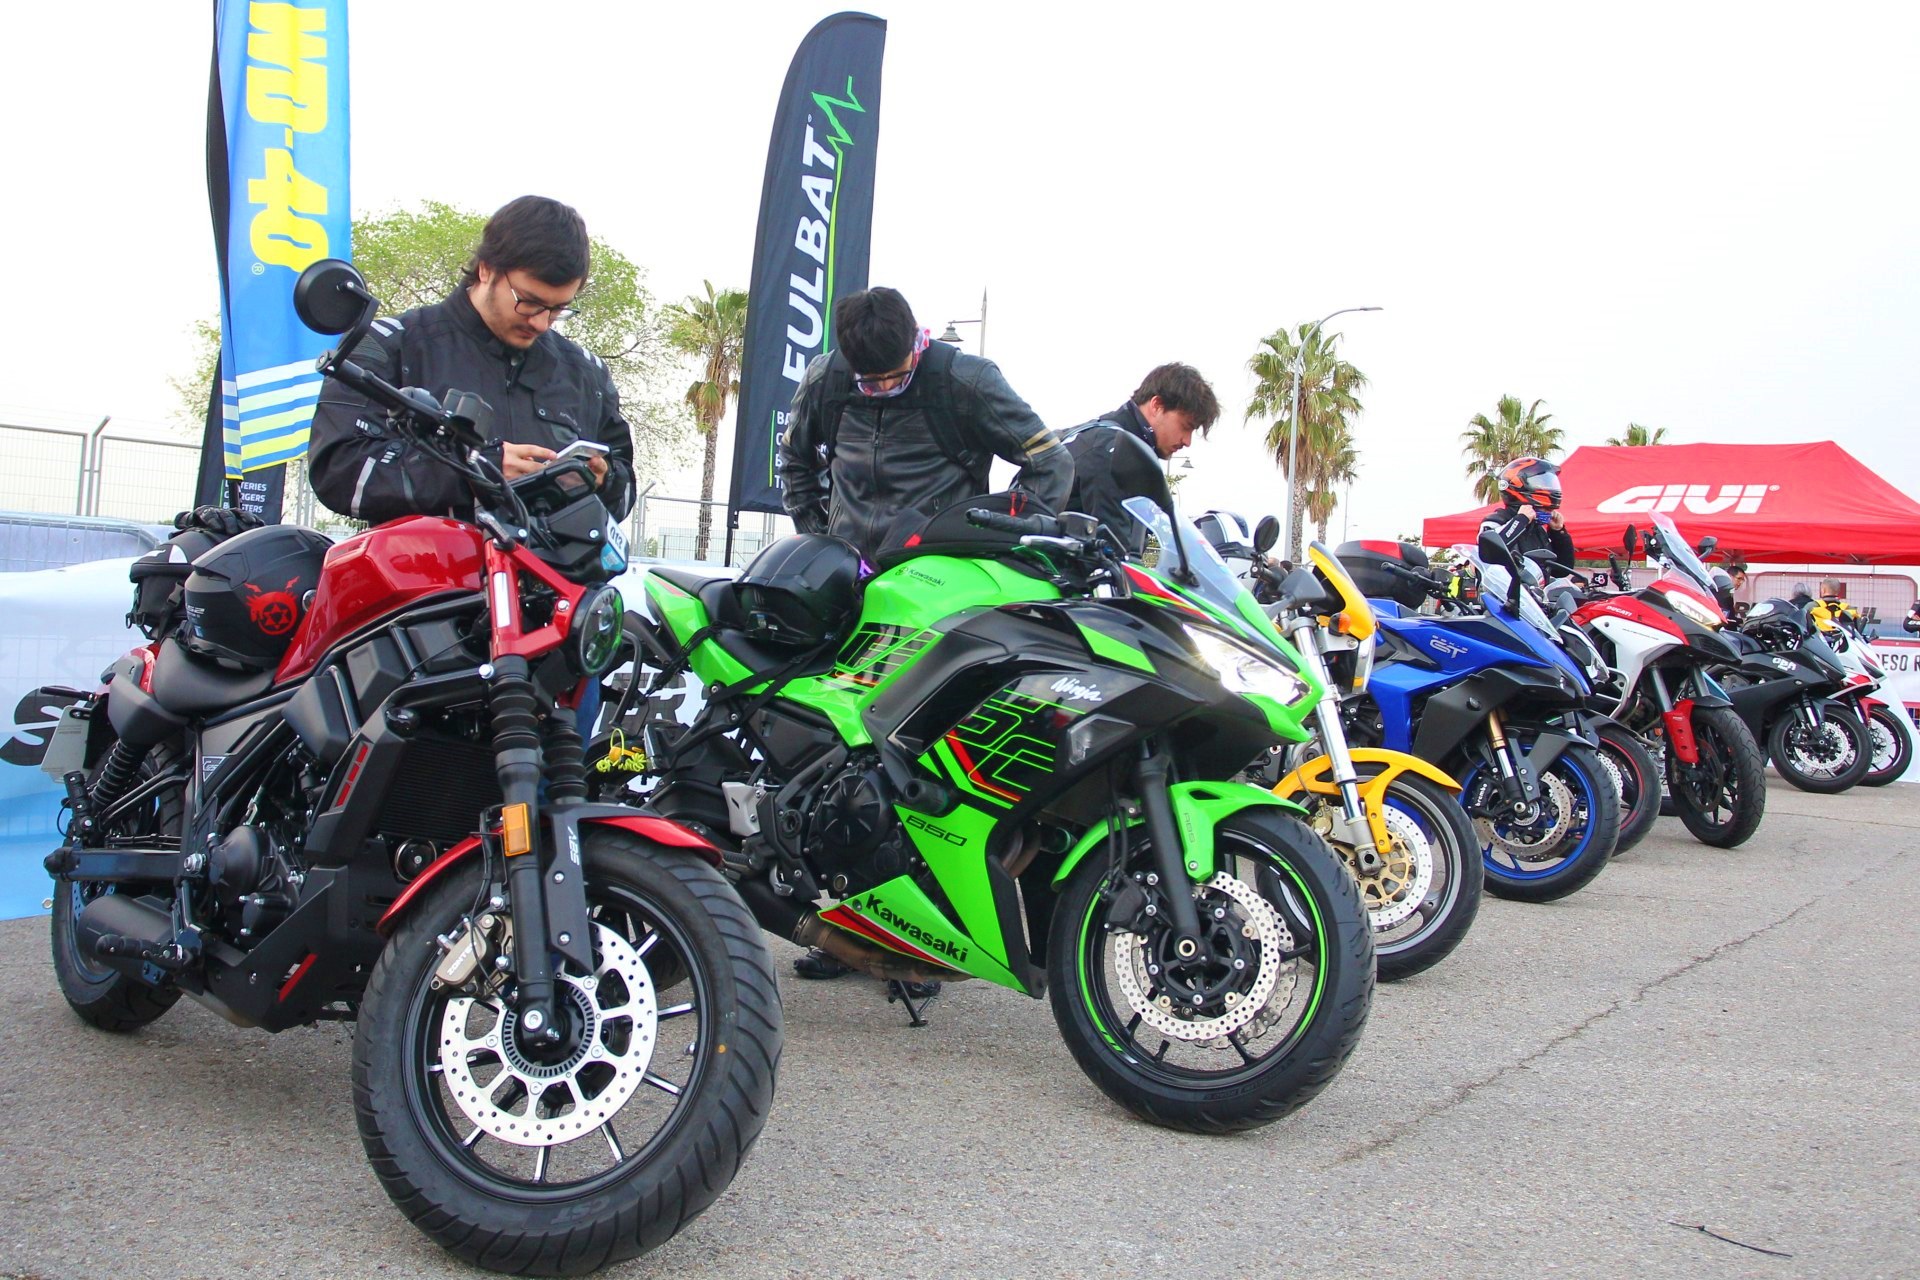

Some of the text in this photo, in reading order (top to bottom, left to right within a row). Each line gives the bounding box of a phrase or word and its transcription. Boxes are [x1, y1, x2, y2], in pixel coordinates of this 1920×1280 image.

[782, 123, 837, 384] FULBAT
[1596, 484, 1768, 514] GIVI
[1606, 605, 1632, 617] DUCATI
[1430, 639, 1467, 658] GT
[1876, 653, 1908, 672] ESO
[1050, 676, 1102, 702] Ninja
[1475, 783, 1488, 807] brembo
[906, 815, 968, 847] 650
[567, 825, 580, 866] ABS
[866, 894, 968, 963] Kawasaki
